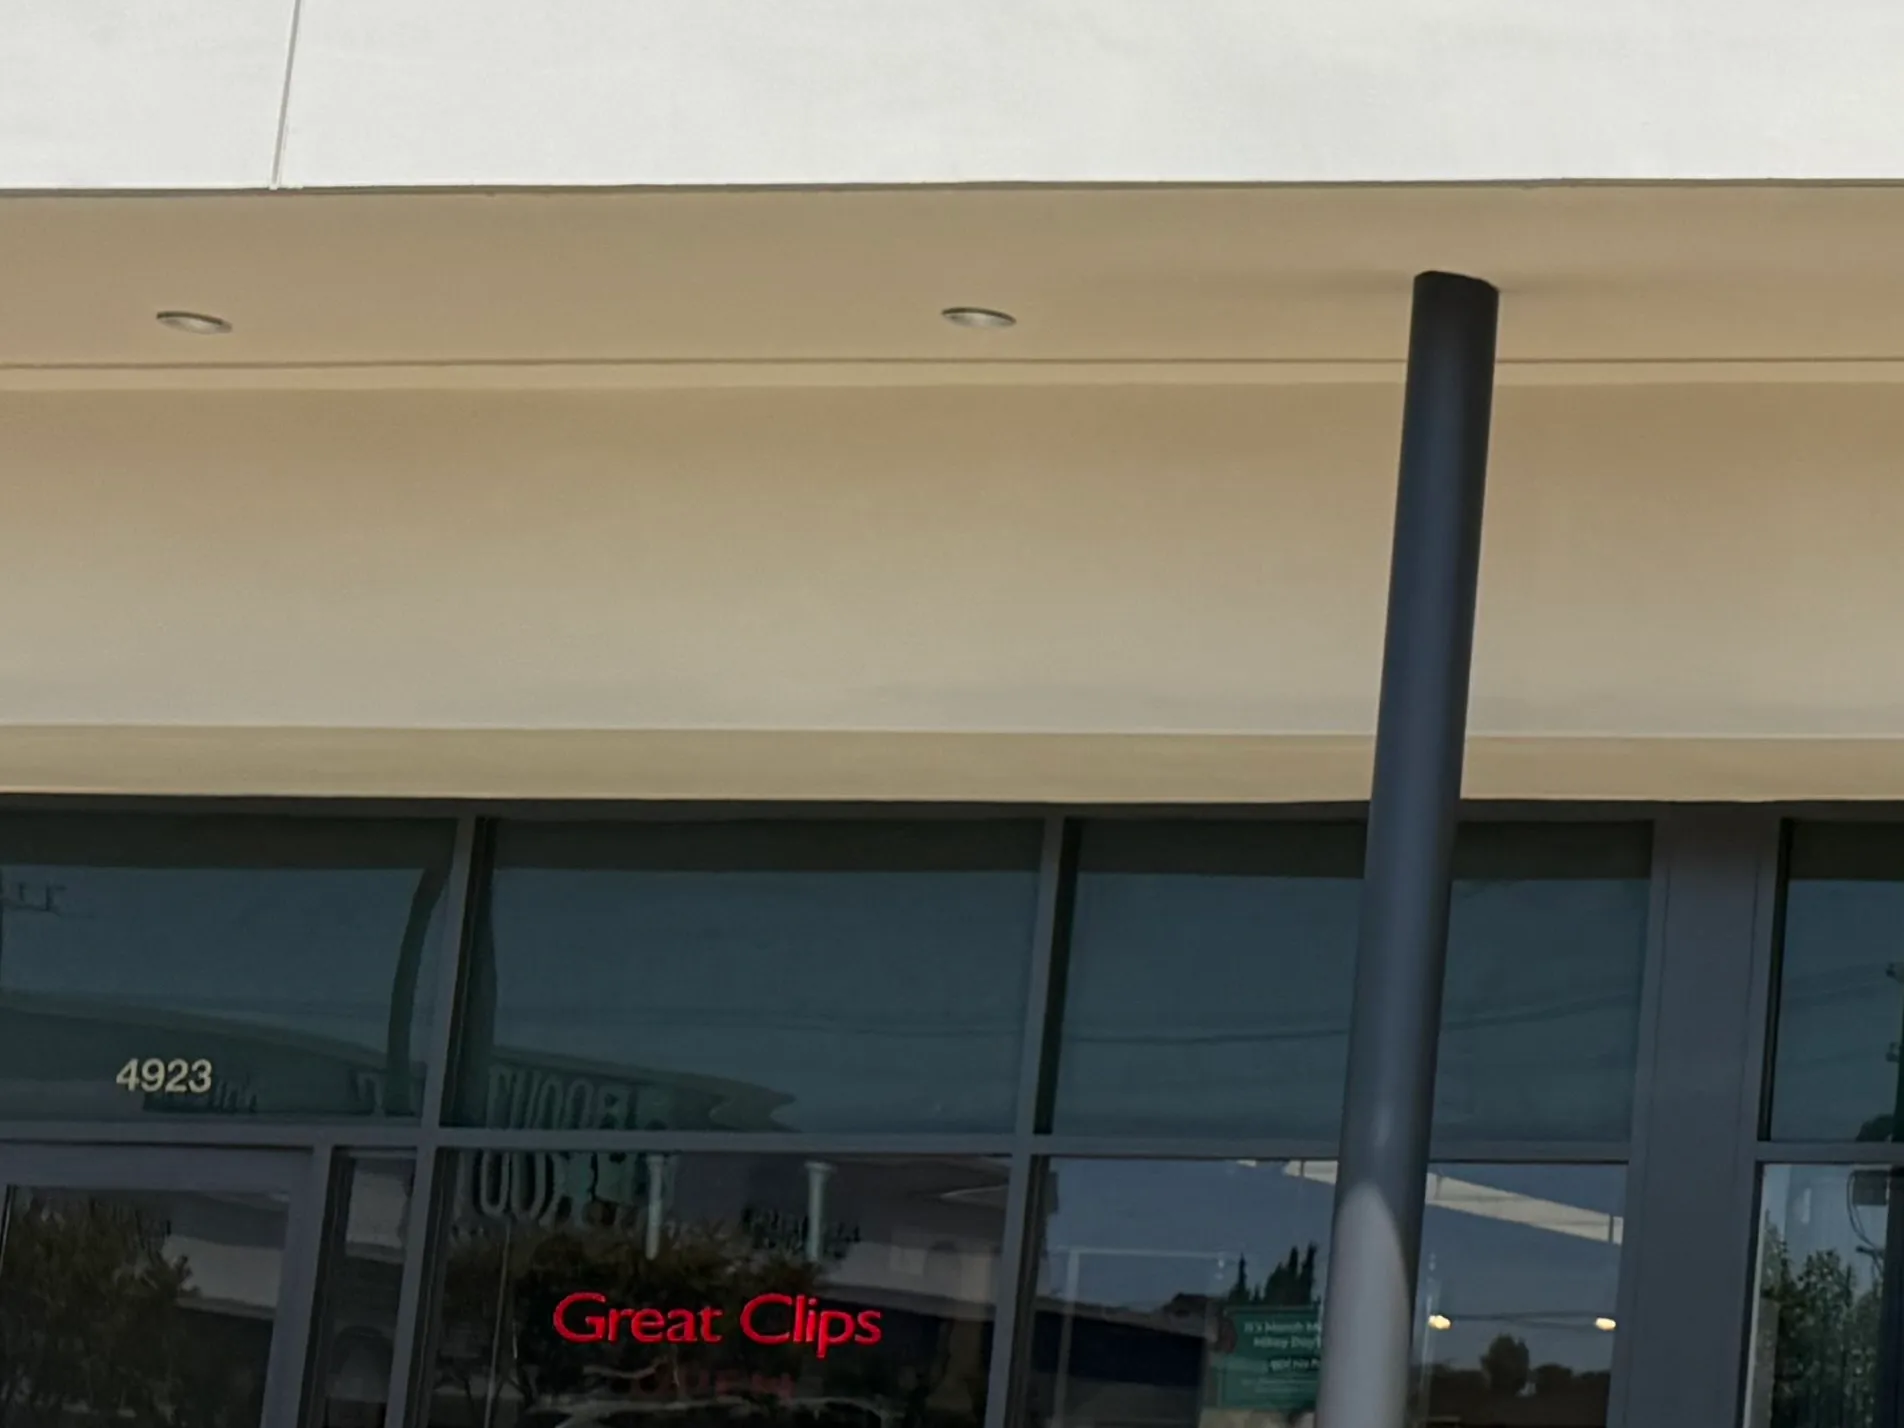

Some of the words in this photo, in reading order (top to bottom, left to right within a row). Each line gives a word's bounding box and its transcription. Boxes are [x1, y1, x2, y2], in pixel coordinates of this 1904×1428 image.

[116, 1058, 212, 1093] 4923
[553, 1292, 722, 1343] Great
[740, 1292, 883, 1359] Clips
